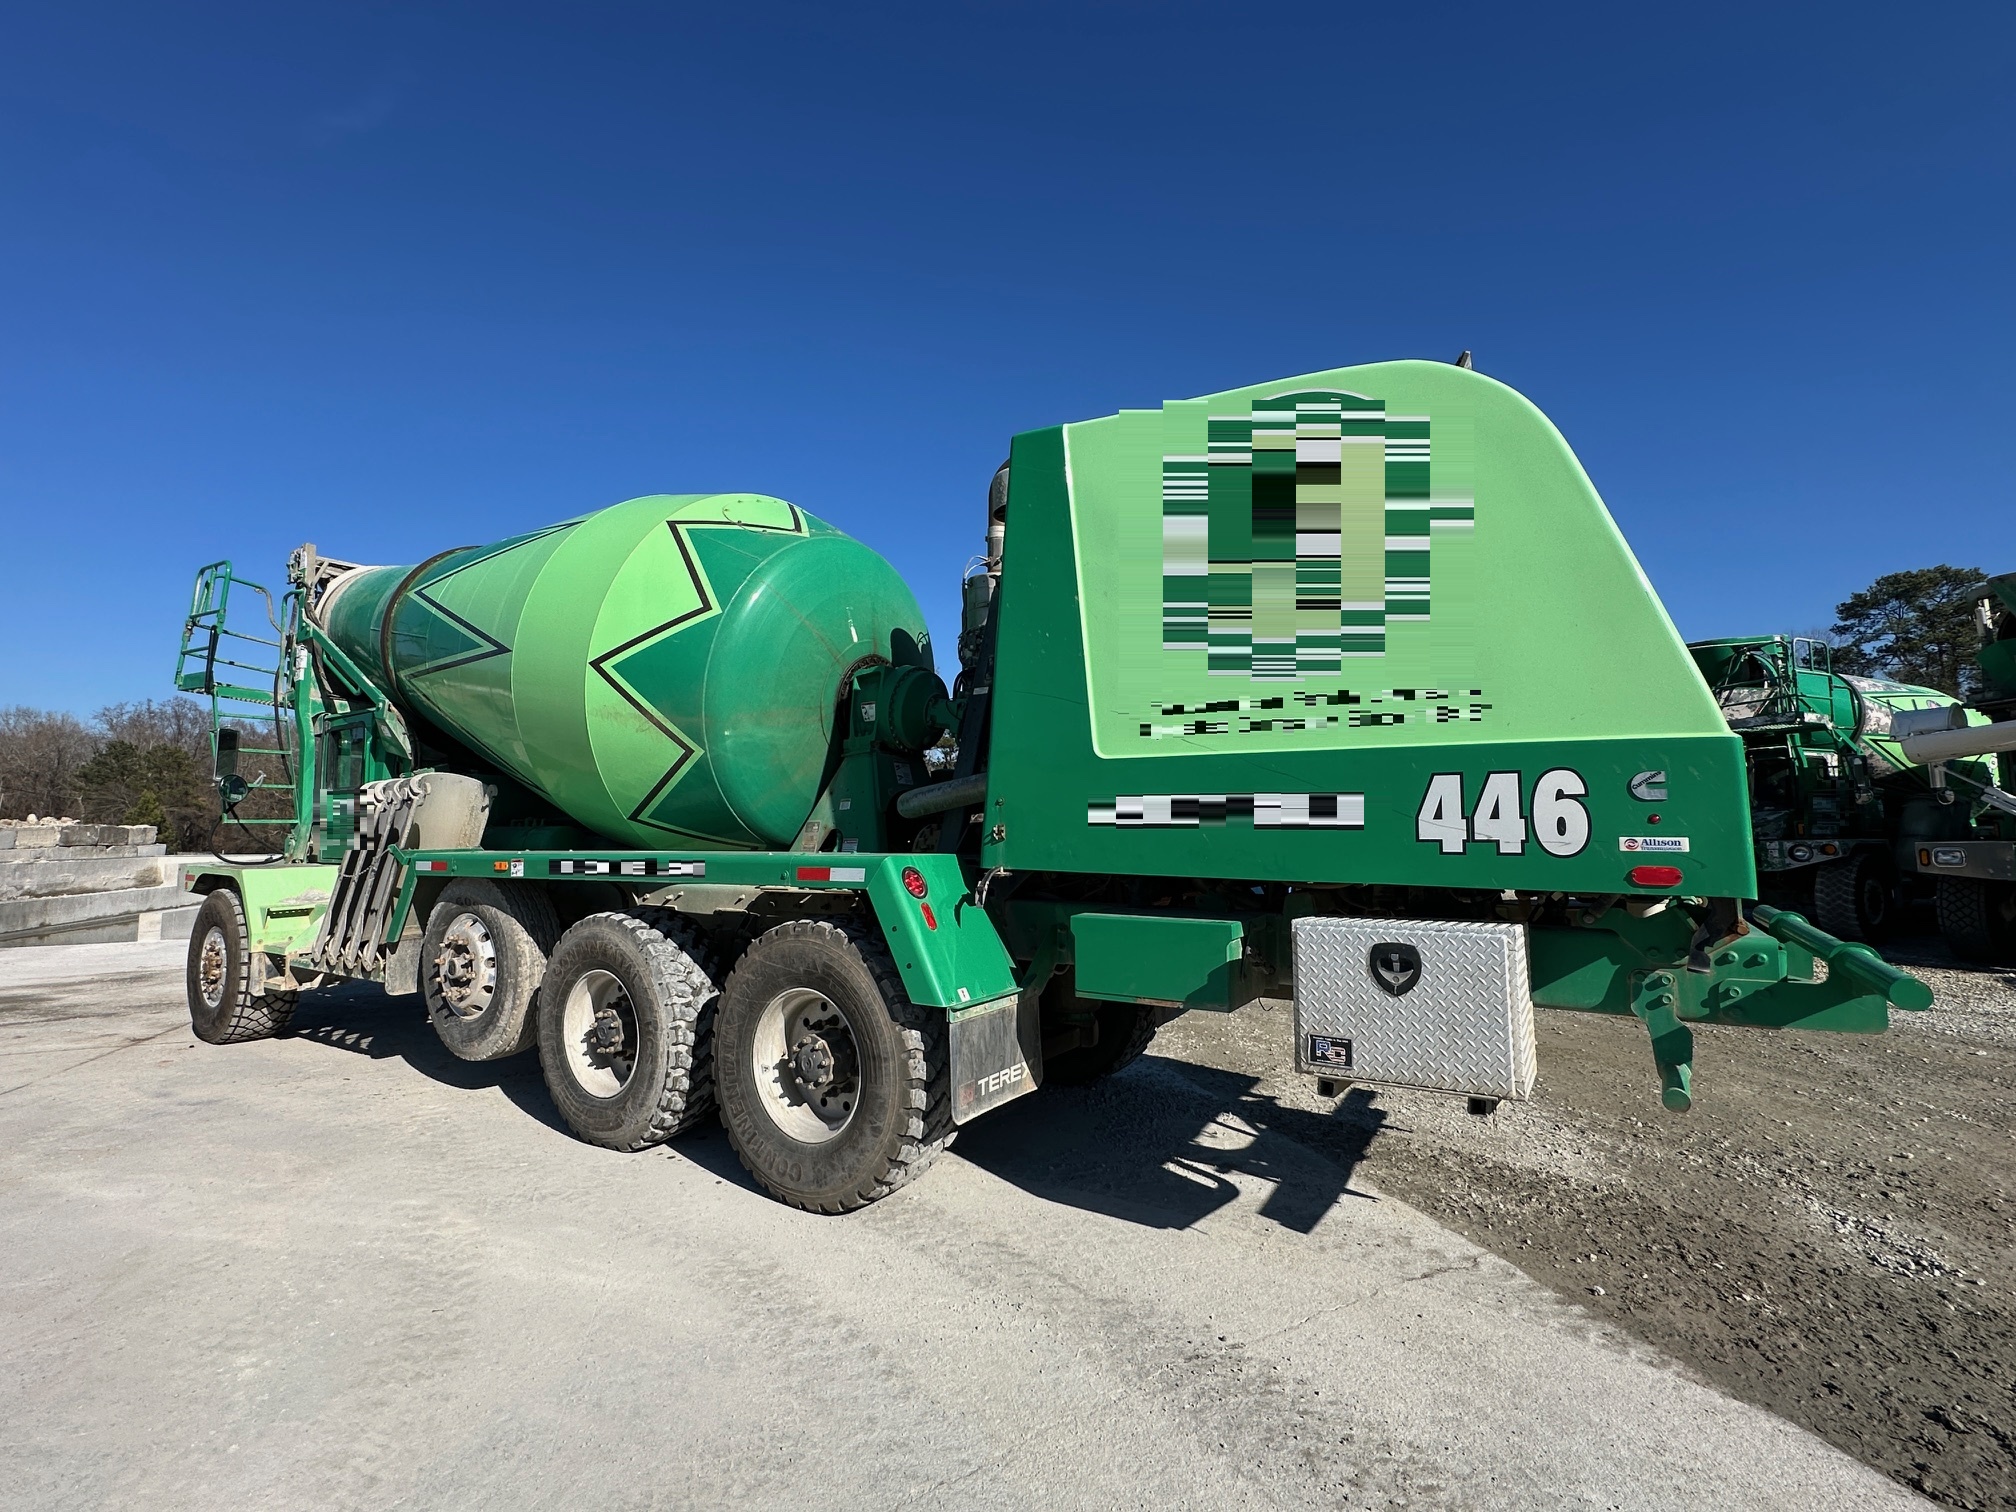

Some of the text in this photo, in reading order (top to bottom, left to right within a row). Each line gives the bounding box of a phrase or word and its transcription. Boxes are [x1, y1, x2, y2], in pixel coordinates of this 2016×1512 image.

[1632, 771, 1662, 790] Cummins
[1416, 767, 1592, 858] 446
[1641, 839, 1681, 847] Allison
